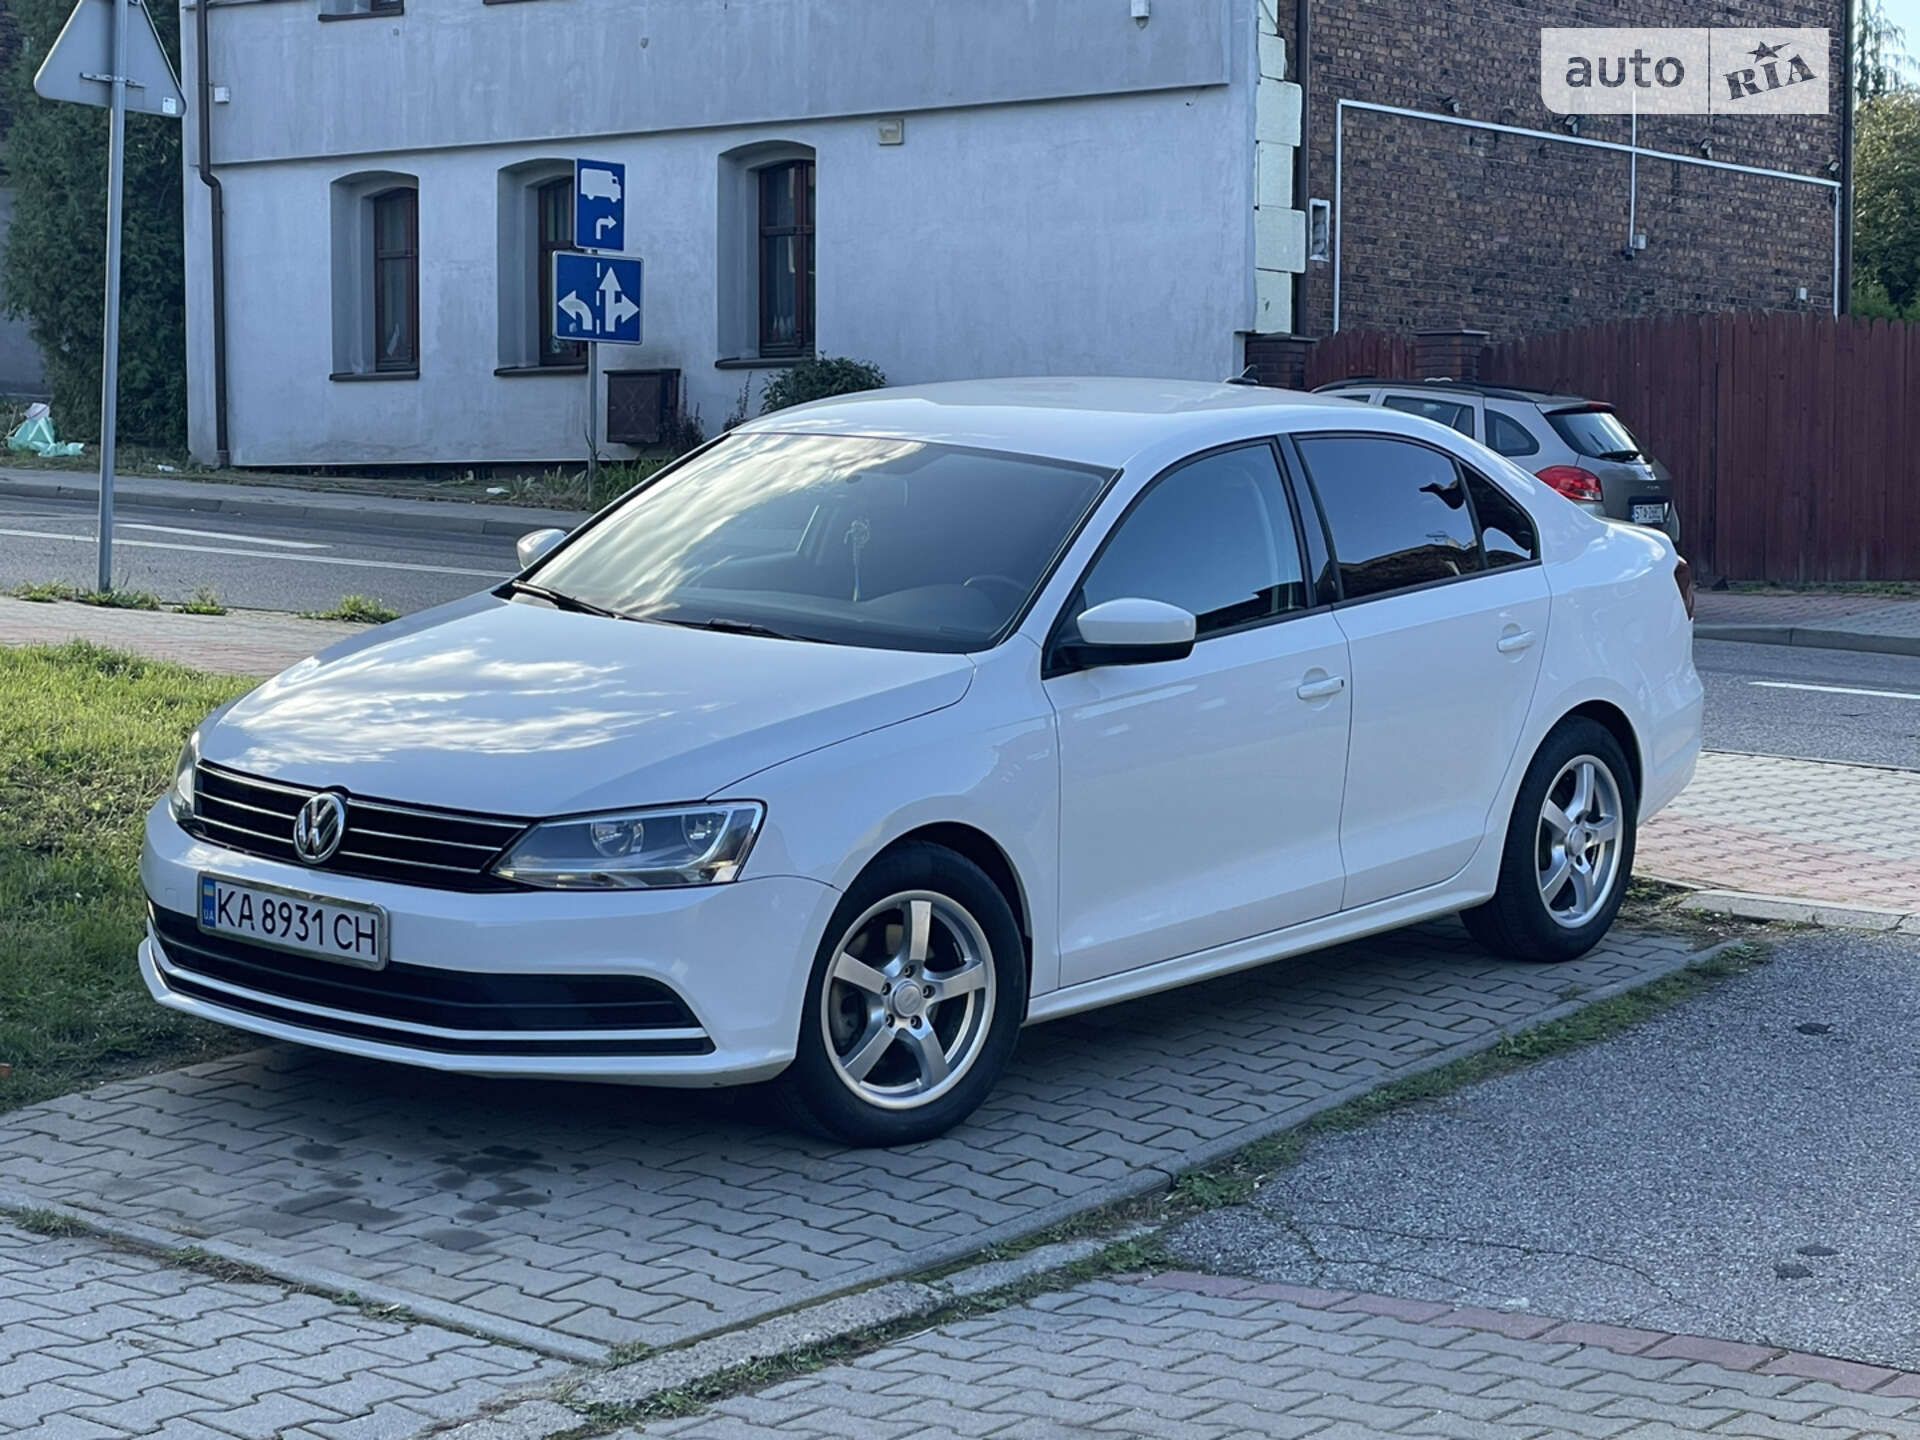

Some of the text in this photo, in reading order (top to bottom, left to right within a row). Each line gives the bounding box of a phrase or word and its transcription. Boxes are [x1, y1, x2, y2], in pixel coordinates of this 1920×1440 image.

[218, 888, 376, 956] KA 8931 CH
